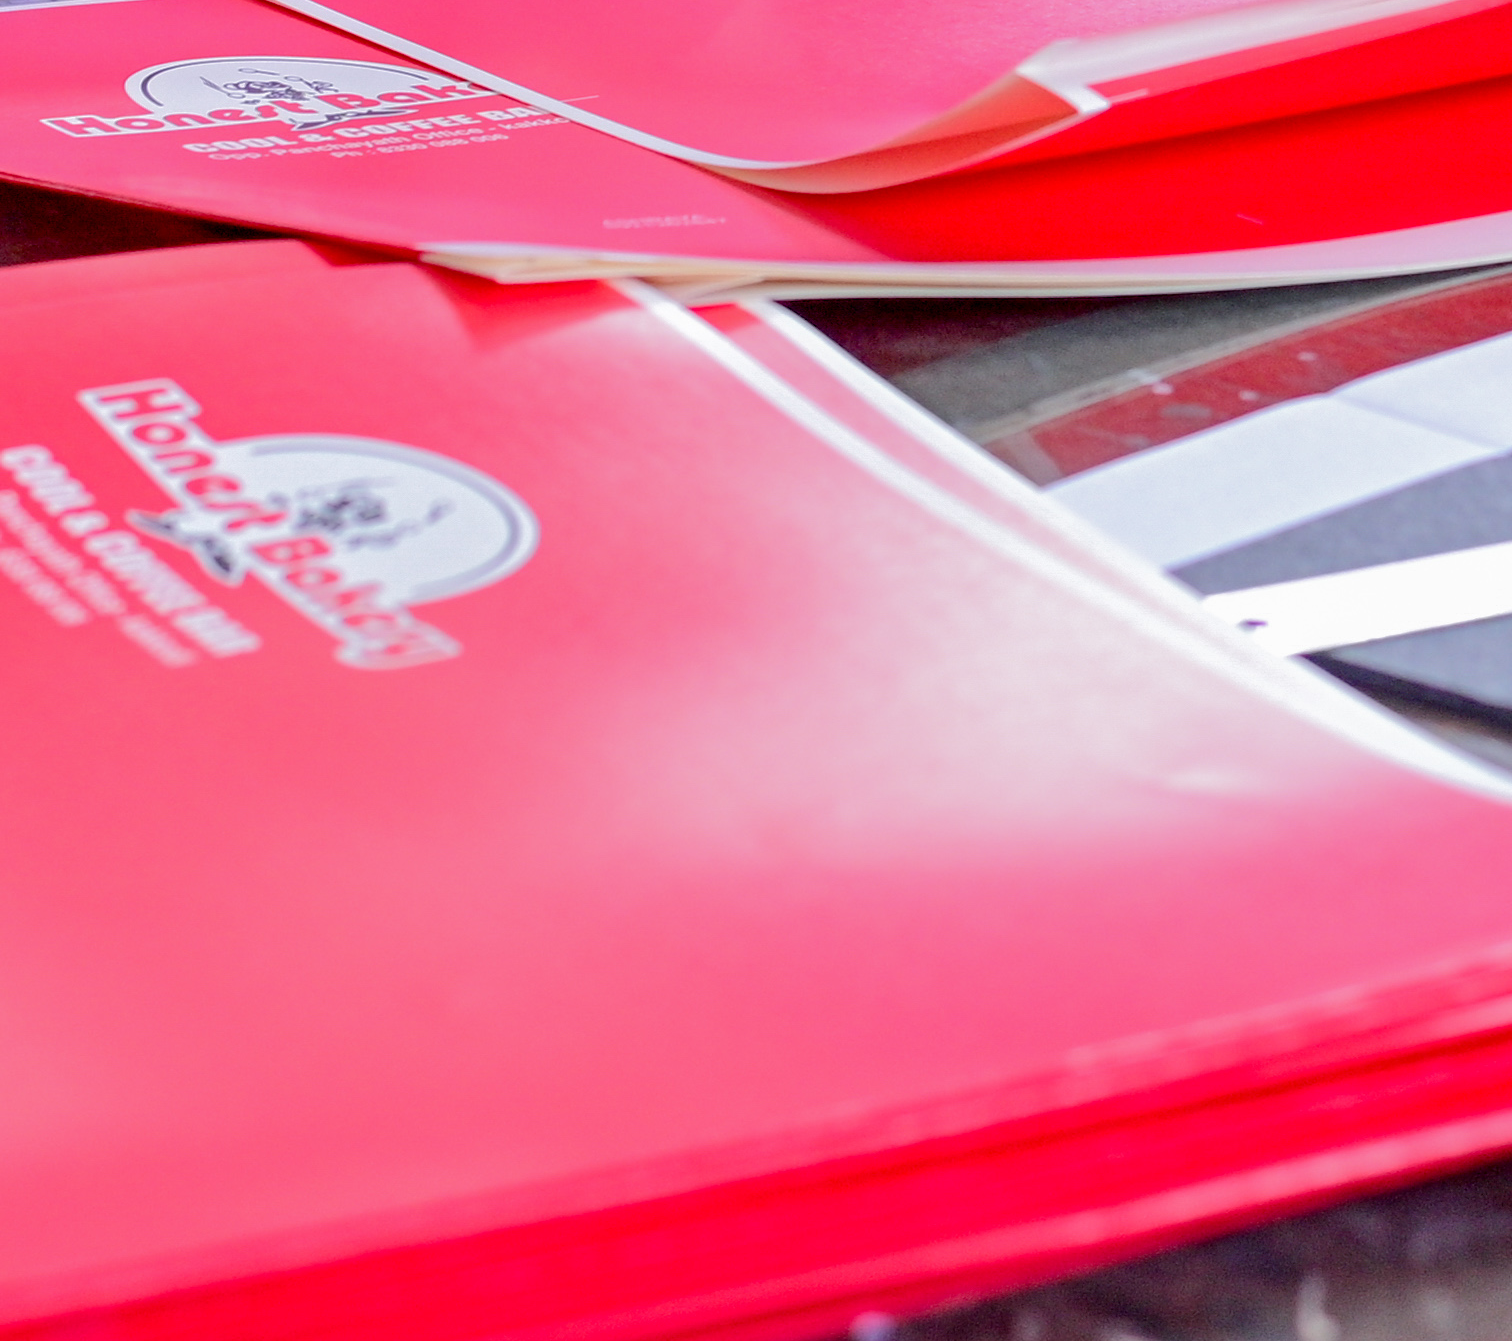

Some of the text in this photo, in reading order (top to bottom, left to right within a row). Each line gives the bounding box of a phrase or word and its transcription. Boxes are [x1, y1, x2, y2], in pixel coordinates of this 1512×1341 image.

[46, 84, 491, 135] Honest Bak
[182, 134, 298, 153] COOL
[299, 132, 336, 143] &
[333, 114, 480, 139] COFFEE
[411, 125, 485, 142] Office
[86, 381, 288, 535] Honest
